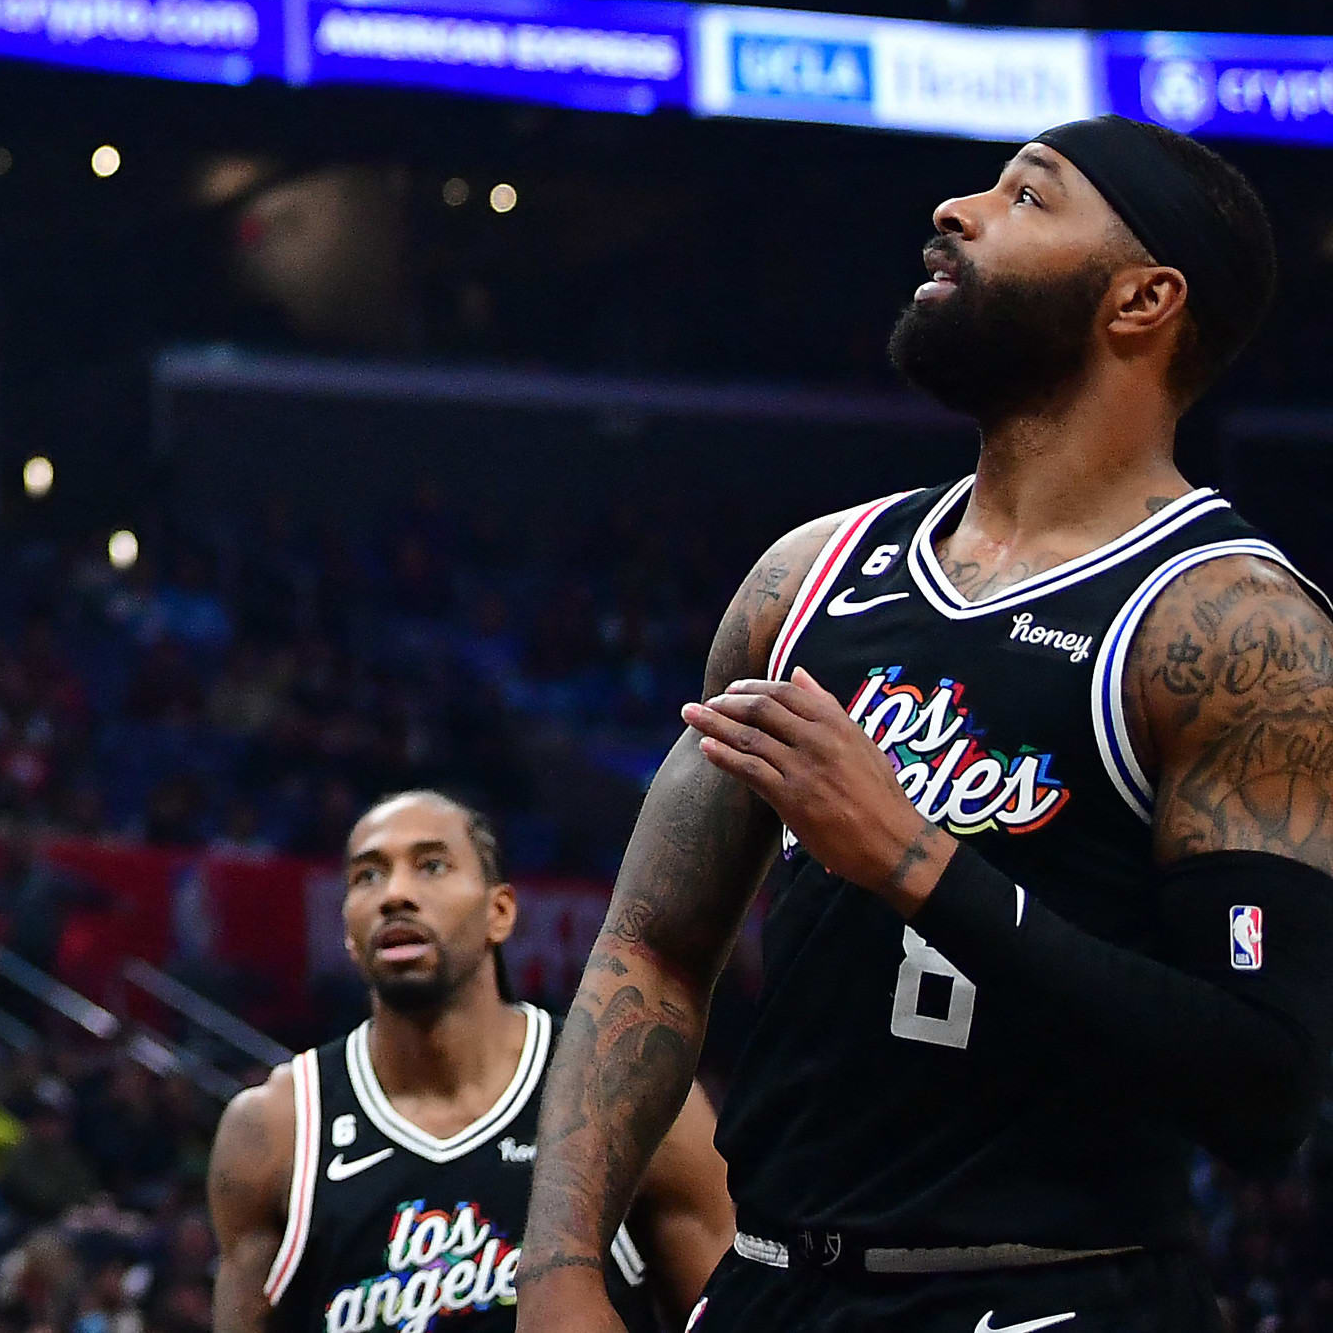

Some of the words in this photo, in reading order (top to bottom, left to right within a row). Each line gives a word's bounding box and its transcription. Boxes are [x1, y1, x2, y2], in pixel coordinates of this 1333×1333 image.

[861, 544, 900, 576] 6
[1009, 611, 1094, 664] honey
[387, 1206, 493, 1272] los
[324, 1237, 523, 1333] angele
